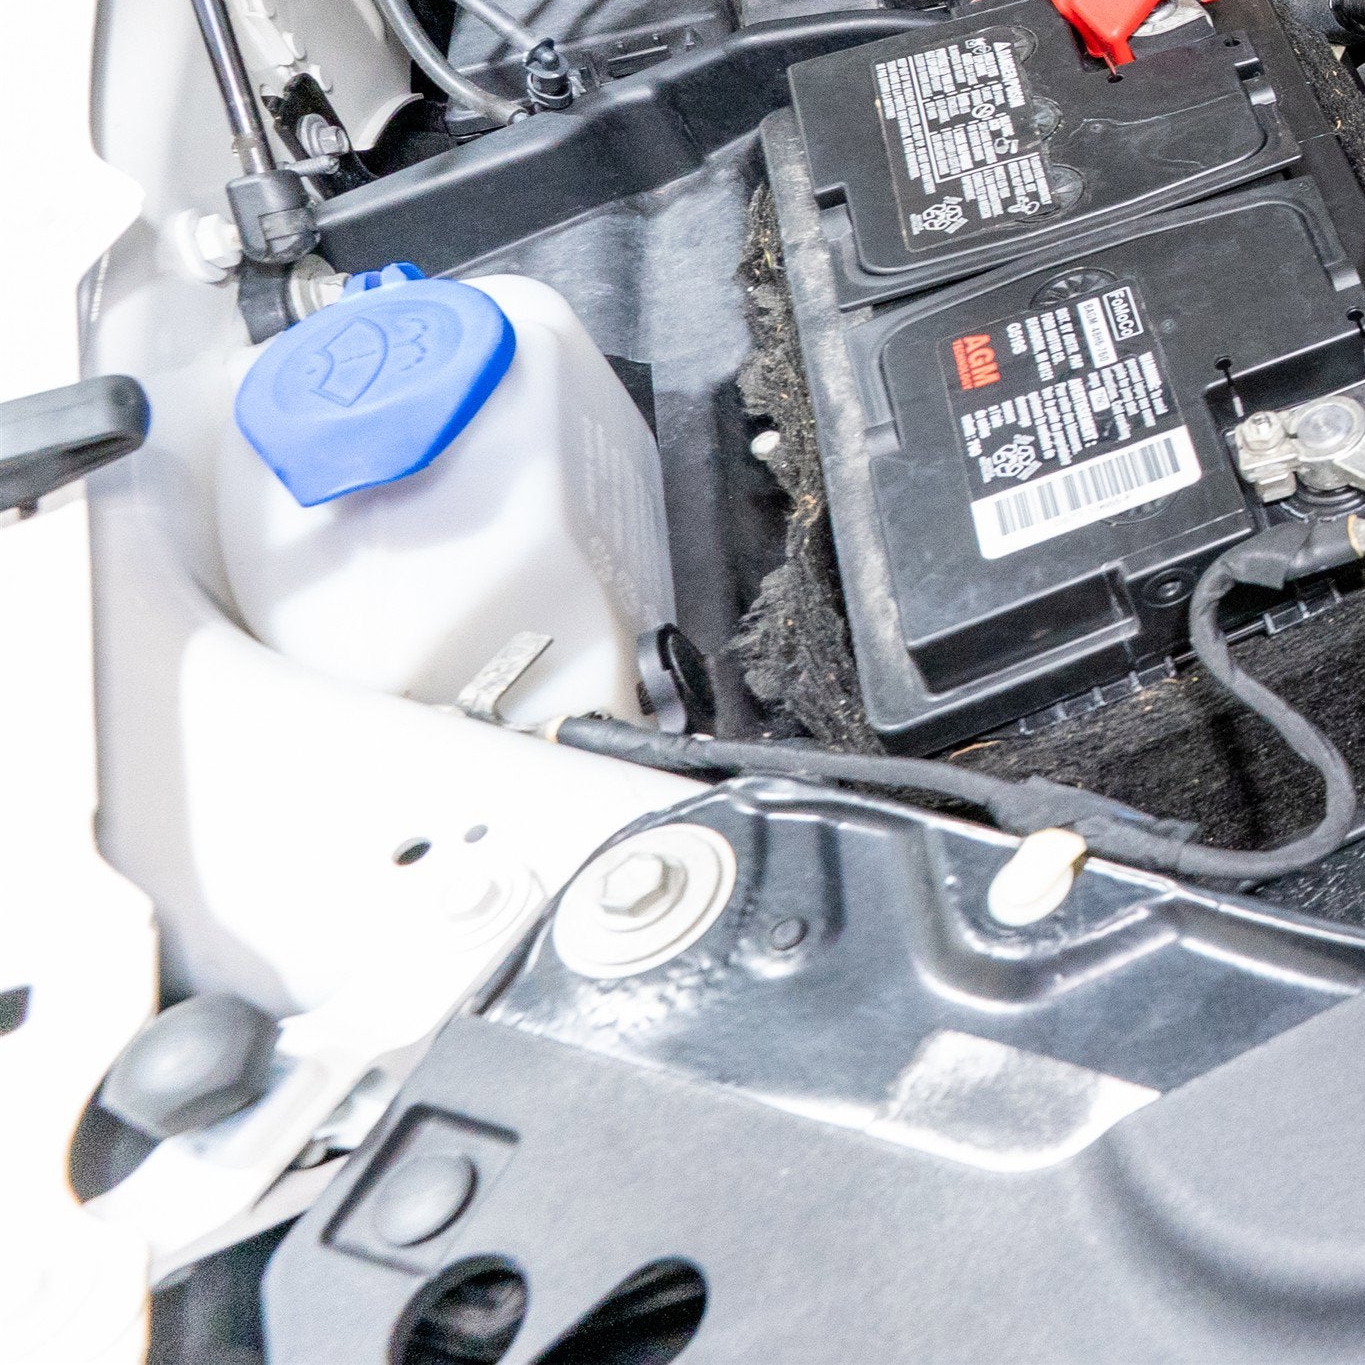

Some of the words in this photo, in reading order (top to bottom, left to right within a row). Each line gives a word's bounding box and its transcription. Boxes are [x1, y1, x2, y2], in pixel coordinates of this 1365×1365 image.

[1041, 312, 1056, 330] FORD
[1106, 289, 1140, 338] FoMoCo
[952, 339, 973, 390] TECHNOLOGY
[963, 335, 999, 387] AGM
[1045, 329, 1063, 353] MOTOR
